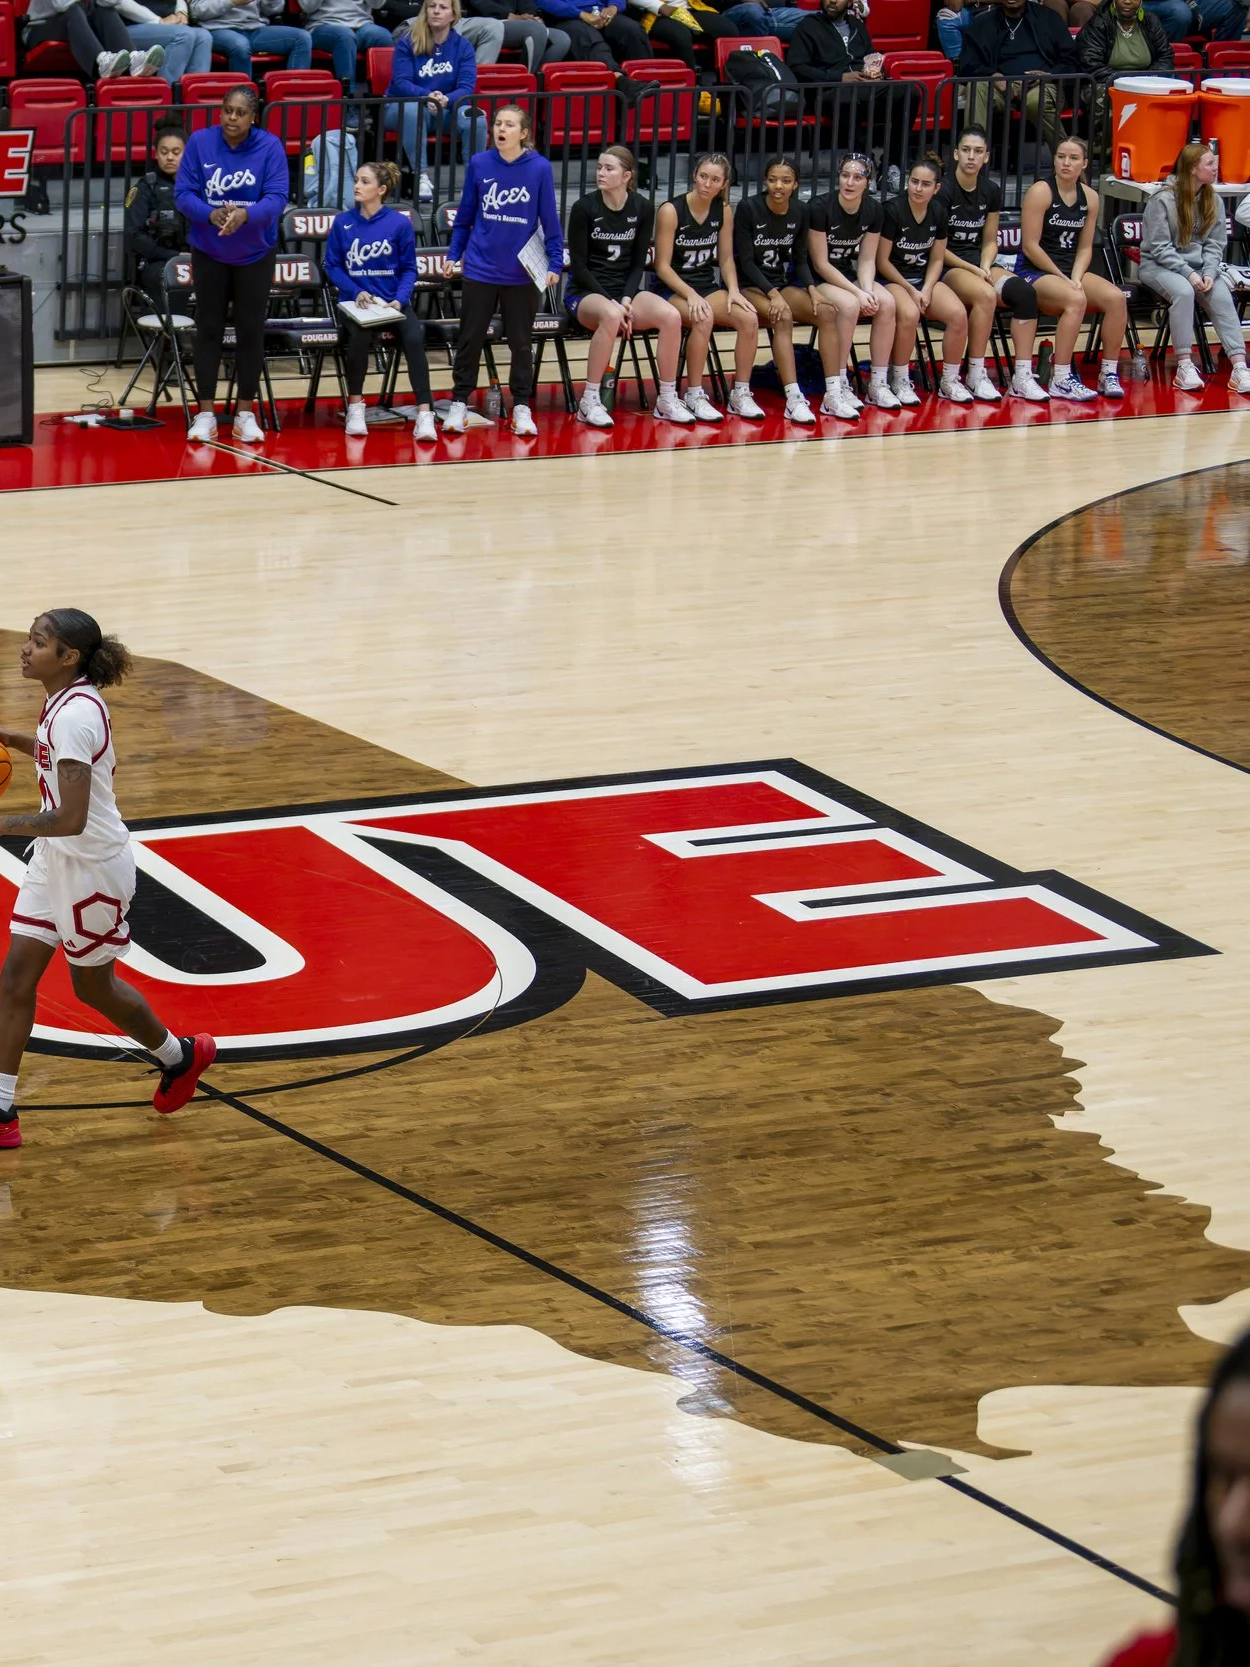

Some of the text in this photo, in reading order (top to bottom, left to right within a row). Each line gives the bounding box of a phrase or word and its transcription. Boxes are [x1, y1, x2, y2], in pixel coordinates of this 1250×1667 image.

[294, 216, 336, 236] SIU
[274, 262, 311, 282] IUE
[300, 333, 339, 343] COUGARS
